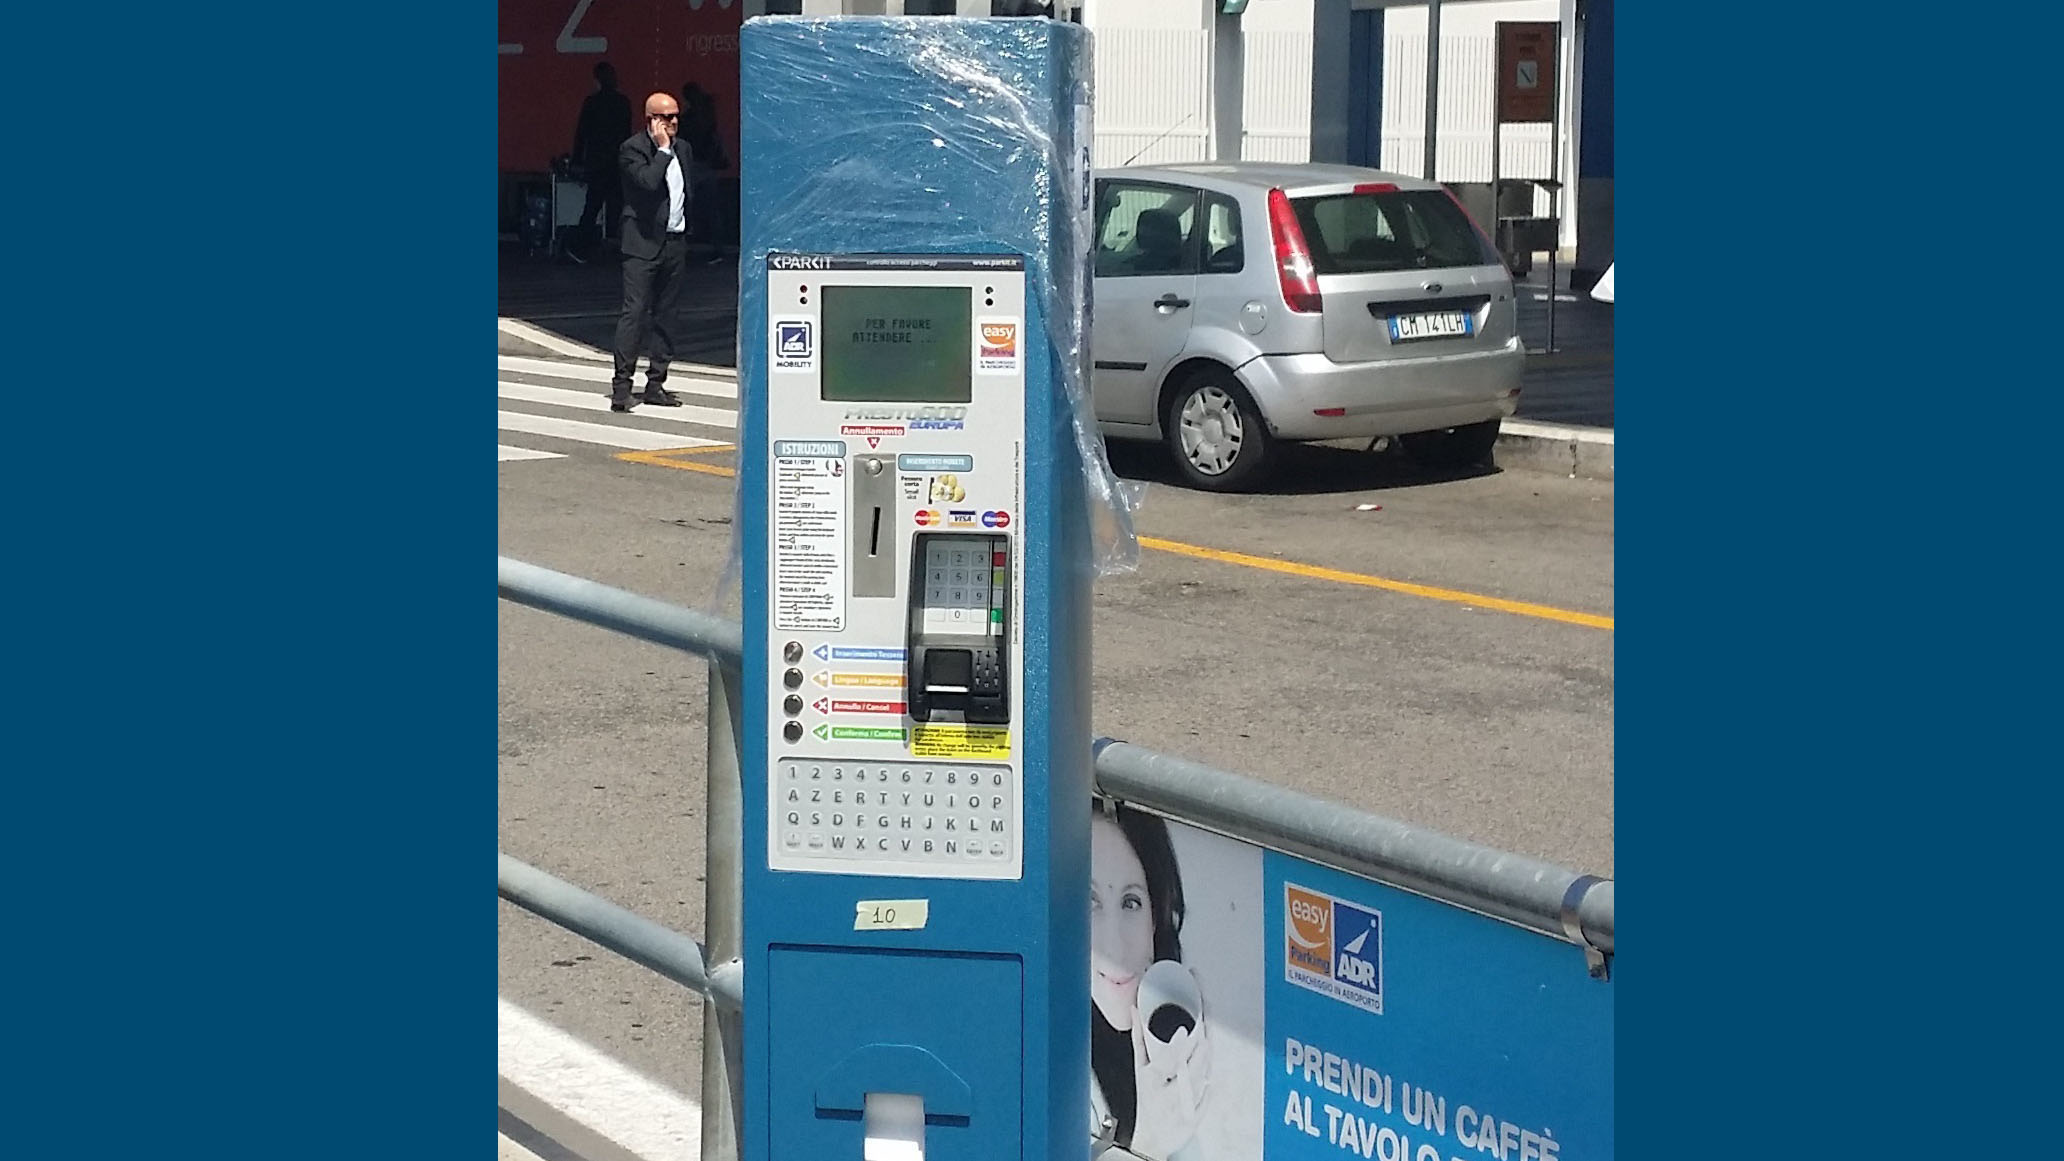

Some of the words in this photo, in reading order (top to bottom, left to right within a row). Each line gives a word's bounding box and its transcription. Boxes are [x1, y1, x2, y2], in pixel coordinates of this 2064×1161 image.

[865, 319, 886, 329] PER
[892, 319, 932, 330] FAVORE
[983, 326, 1015, 341] easy
[1401, 315, 1419, 335] CM
[852, 332, 913, 343] ATTENDERE
[842, 427, 904, 436] Annullamento
[781, 442, 840, 455] ISTRUZIONI
[866, 704, 890, 712] Cancel
[790, 766, 796, 780] 1
[810, 767, 822, 780] 2
[833, 768, 843, 781] 3
[856, 769, 865, 781] 4
[879, 770, 888, 783] 5
[901, 770, 911, 784] 6
[924, 771, 933, 784] 7
[947, 772, 957, 785] 8
[969, 773, 979, 786] 9
[992, 774, 1002, 787] 0
[788, 789, 800, 802] A
[810, 790, 821, 803] Z
[833, 790, 843, 804] E
[855, 791, 866, 805] R
[879, 792, 888, 806] T
[902, 793, 911, 807] Y
[923, 793, 934, 808] U
[968, 795, 980, 809] O
[992, 796, 1002, 810] P
[787, 812, 800, 826] Q
[811, 812, 820, 826] S
[832, 813, 844, 827] D
[856, 814, 865, 828] F
[878, 815, 889, 829] G
[900, 816, 912, 829] H
[925, 817, 933, 831] J
[945, 818, 956, 831] K
[969, 818, 980, 832] L
[990, 819, 1004, 833] M
[831, 836, 846, 849] W
[855, 837, 866, 850] X
[878, 838, 888, 852] C
[901, 839, 911, 852] V
[923, 840, 933, 853] B
[945, 840, 957, 854] N
[873, 907, 896, 923] 10
[1291, 899, 1329, 933] easy
[1291, 944, 1330, 974] Parking
[1337, 952, 1377, 989] ADR
[1295, 971, 1333, 994] PARCHEGGIO
[1343, 989, 1380, 1010] AEROPORTO
[1286, 1037, 1392, 1115] PRENDI
[1401, 1081, 1446, 1136] UN
[1283, 1089, 1321, 1138] AL
